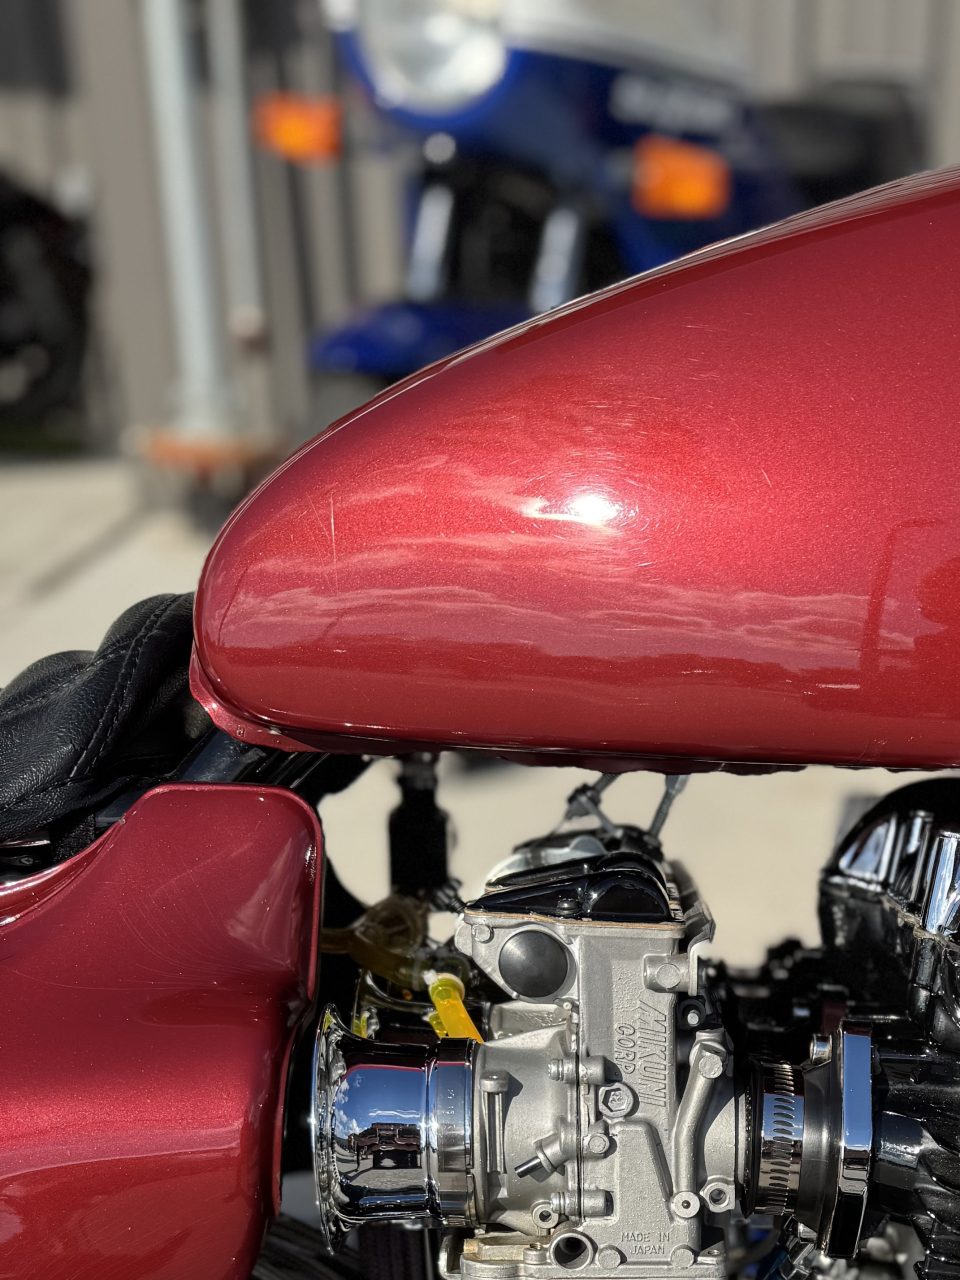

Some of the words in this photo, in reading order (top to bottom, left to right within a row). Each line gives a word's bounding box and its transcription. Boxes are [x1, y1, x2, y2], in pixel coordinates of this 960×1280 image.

[638, 999, 667, 1107] MIKUNI
[621, 1231, 651, 1243] MADE
[659, 1231, 670, 1243] IN
[631, 1245, 665, 1255] JAPAN
